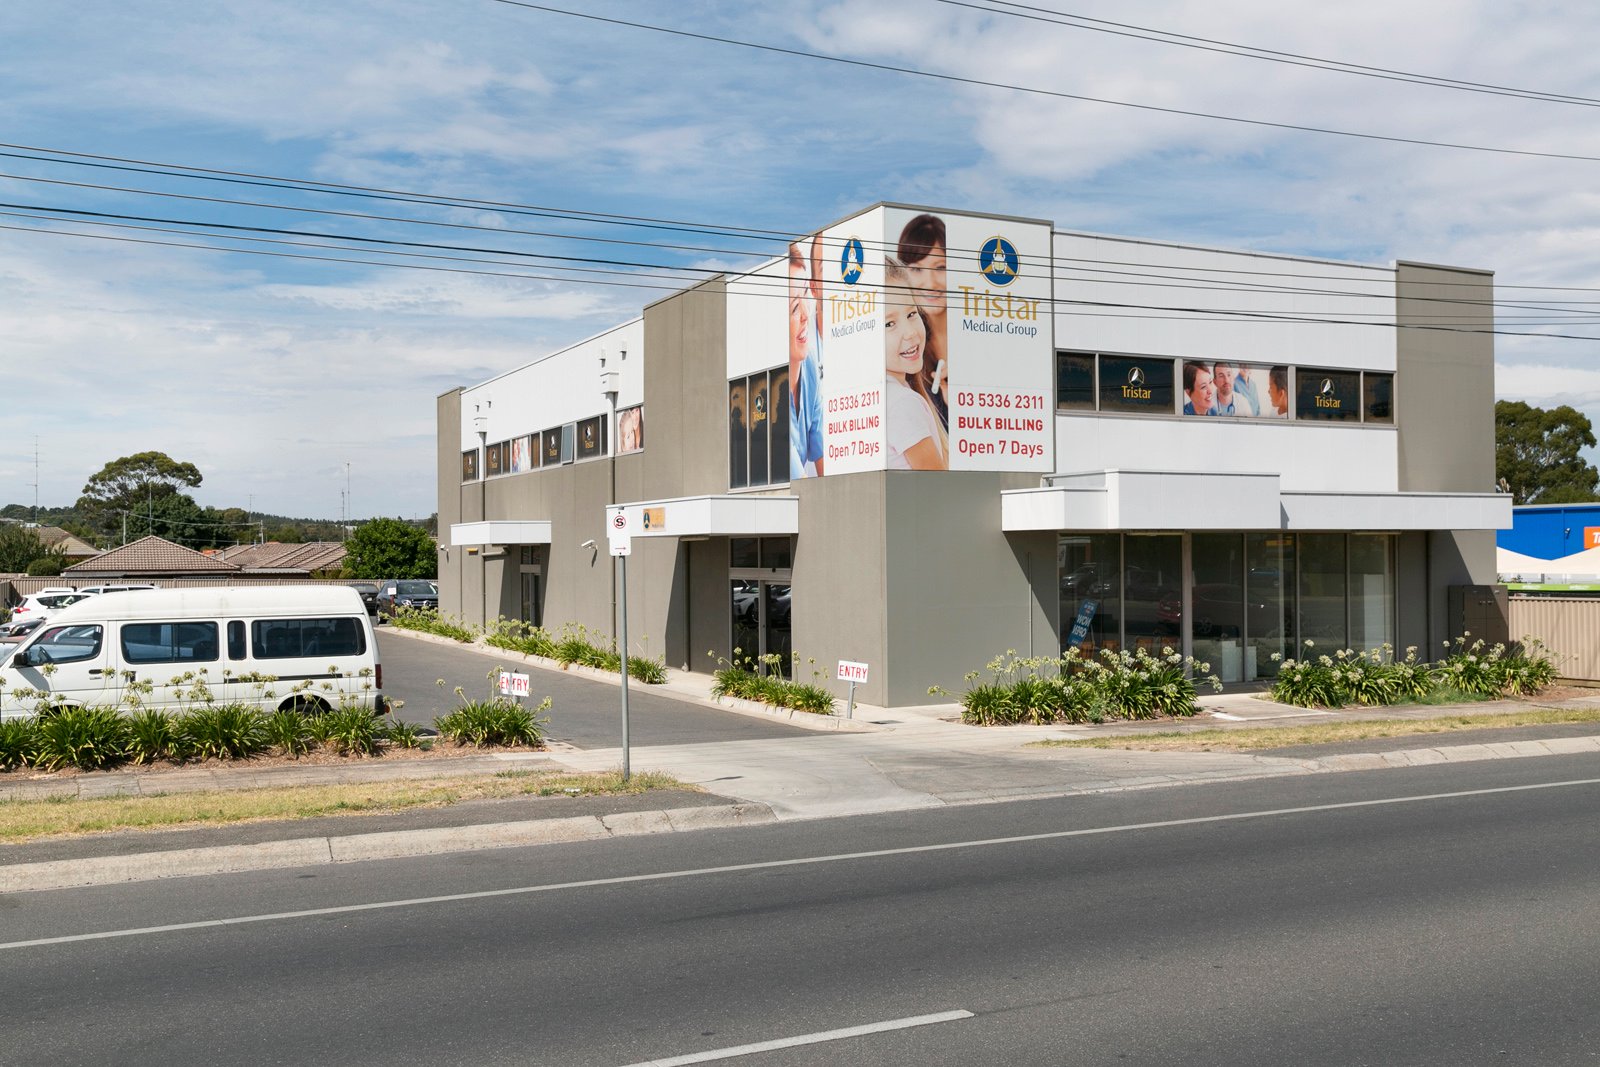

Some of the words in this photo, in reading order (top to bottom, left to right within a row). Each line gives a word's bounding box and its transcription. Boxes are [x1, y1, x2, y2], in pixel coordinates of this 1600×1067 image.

[829, 289, 877, 324] Tristar
[958, 285, 1040, 321] Tristar
[831, 322, 855, 338] Medical
[856, 319, 876, 332] Group
[962, 319, 1003, 334] Medical
[1006, 322, 1038, 339] Group
[828, 399, 838, 413] 03
[839, 394, 859, 411] 5336
[861, 390, 880, 408] 2311
[958, 391, 974, 407] 03
[978, 393, 1011, 409] 5336
[1015, 394, 1043, 410] 2311
[1121, 385, 1152, 399] Tristar
[1314, 395, 1342, 408] Tristar
[828, 420, 848, 435] BULK
[849, 415, 880, 432] BILLING
[958, 416, 992, 430] BULK
[995, 417, 1043, 432] BILLING
[828, 444, 850, 461] Open
[851, 441, 856, 456] 7
[858, 440, 880, 457] Days
[958, 438, 995, 457] Open
[998, 440, 1007, 455] 7
[1011, 440, 1044, 459] Days
[839, 664, 867, 679] ENTRY
